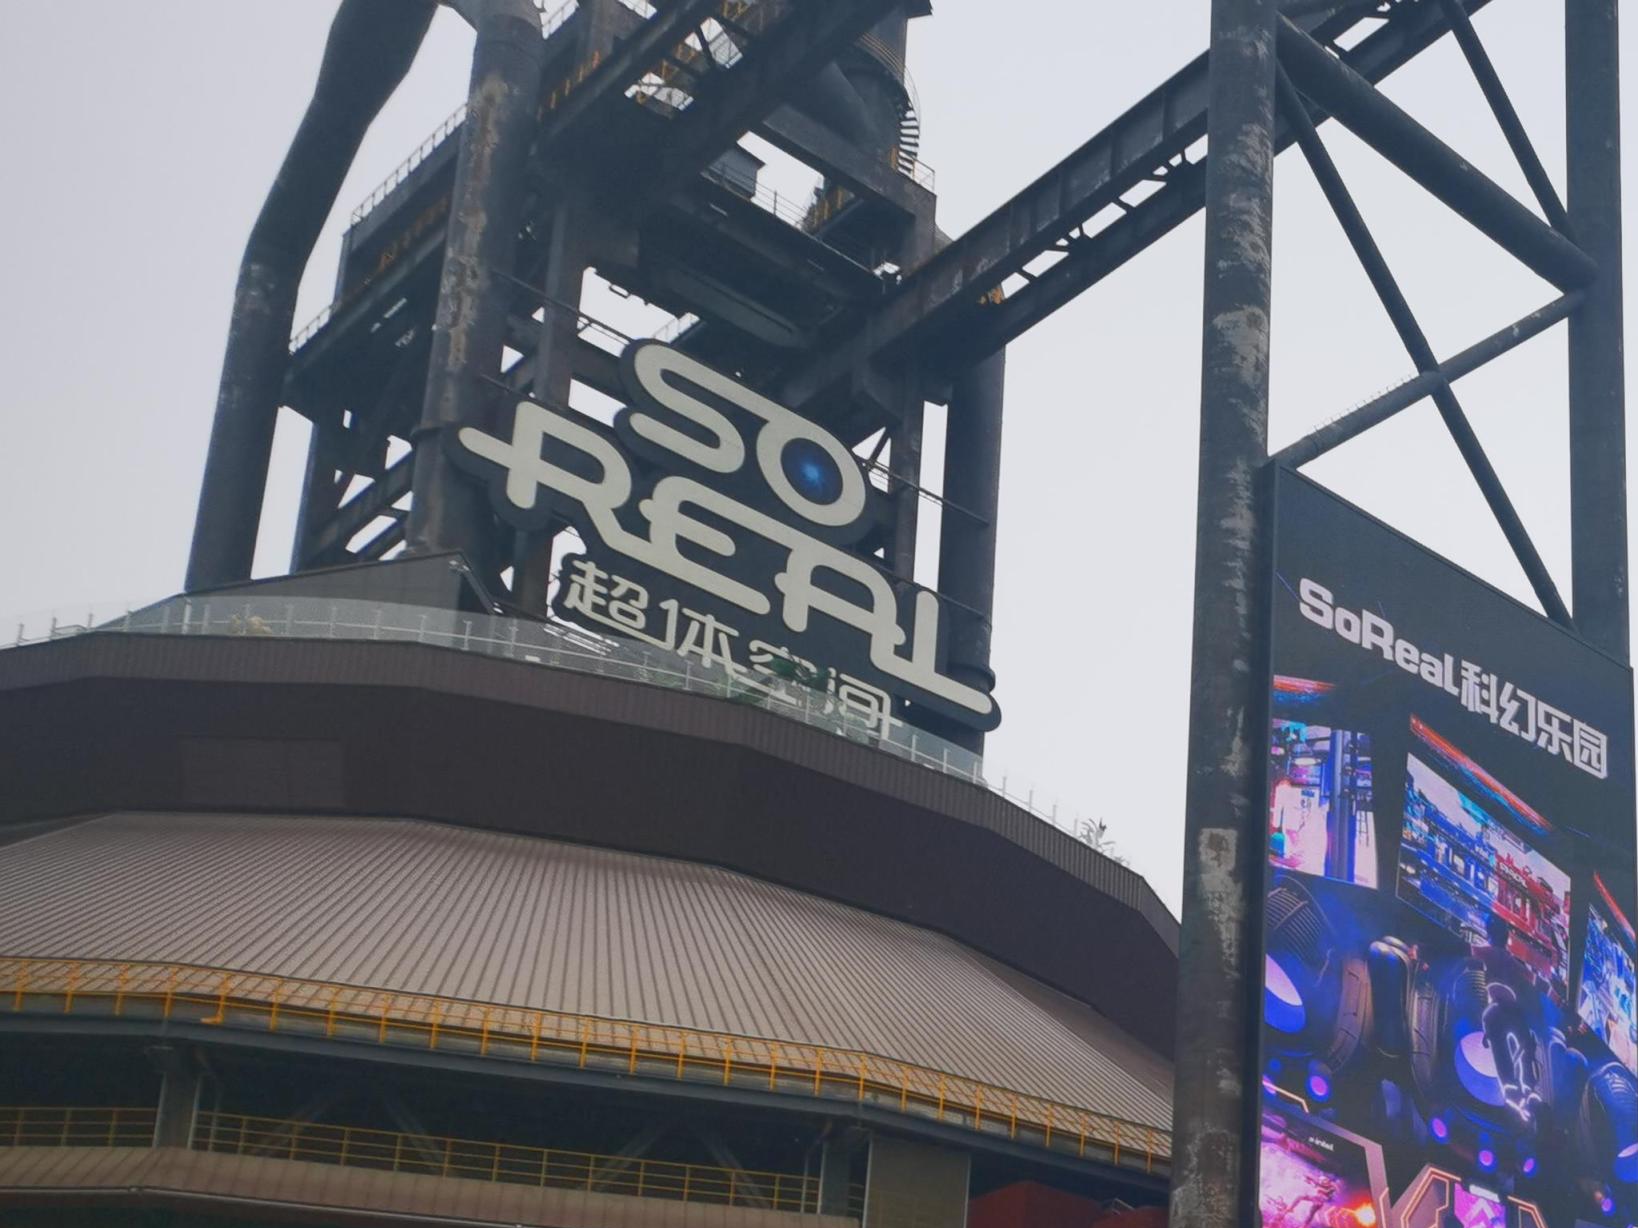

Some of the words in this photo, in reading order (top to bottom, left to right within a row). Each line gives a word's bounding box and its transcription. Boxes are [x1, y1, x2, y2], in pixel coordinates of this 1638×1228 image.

[633, 340, 866, 527] SO
[458, 400, 993, 715] REAL
[562, 558, 903, 739] 超体空间
